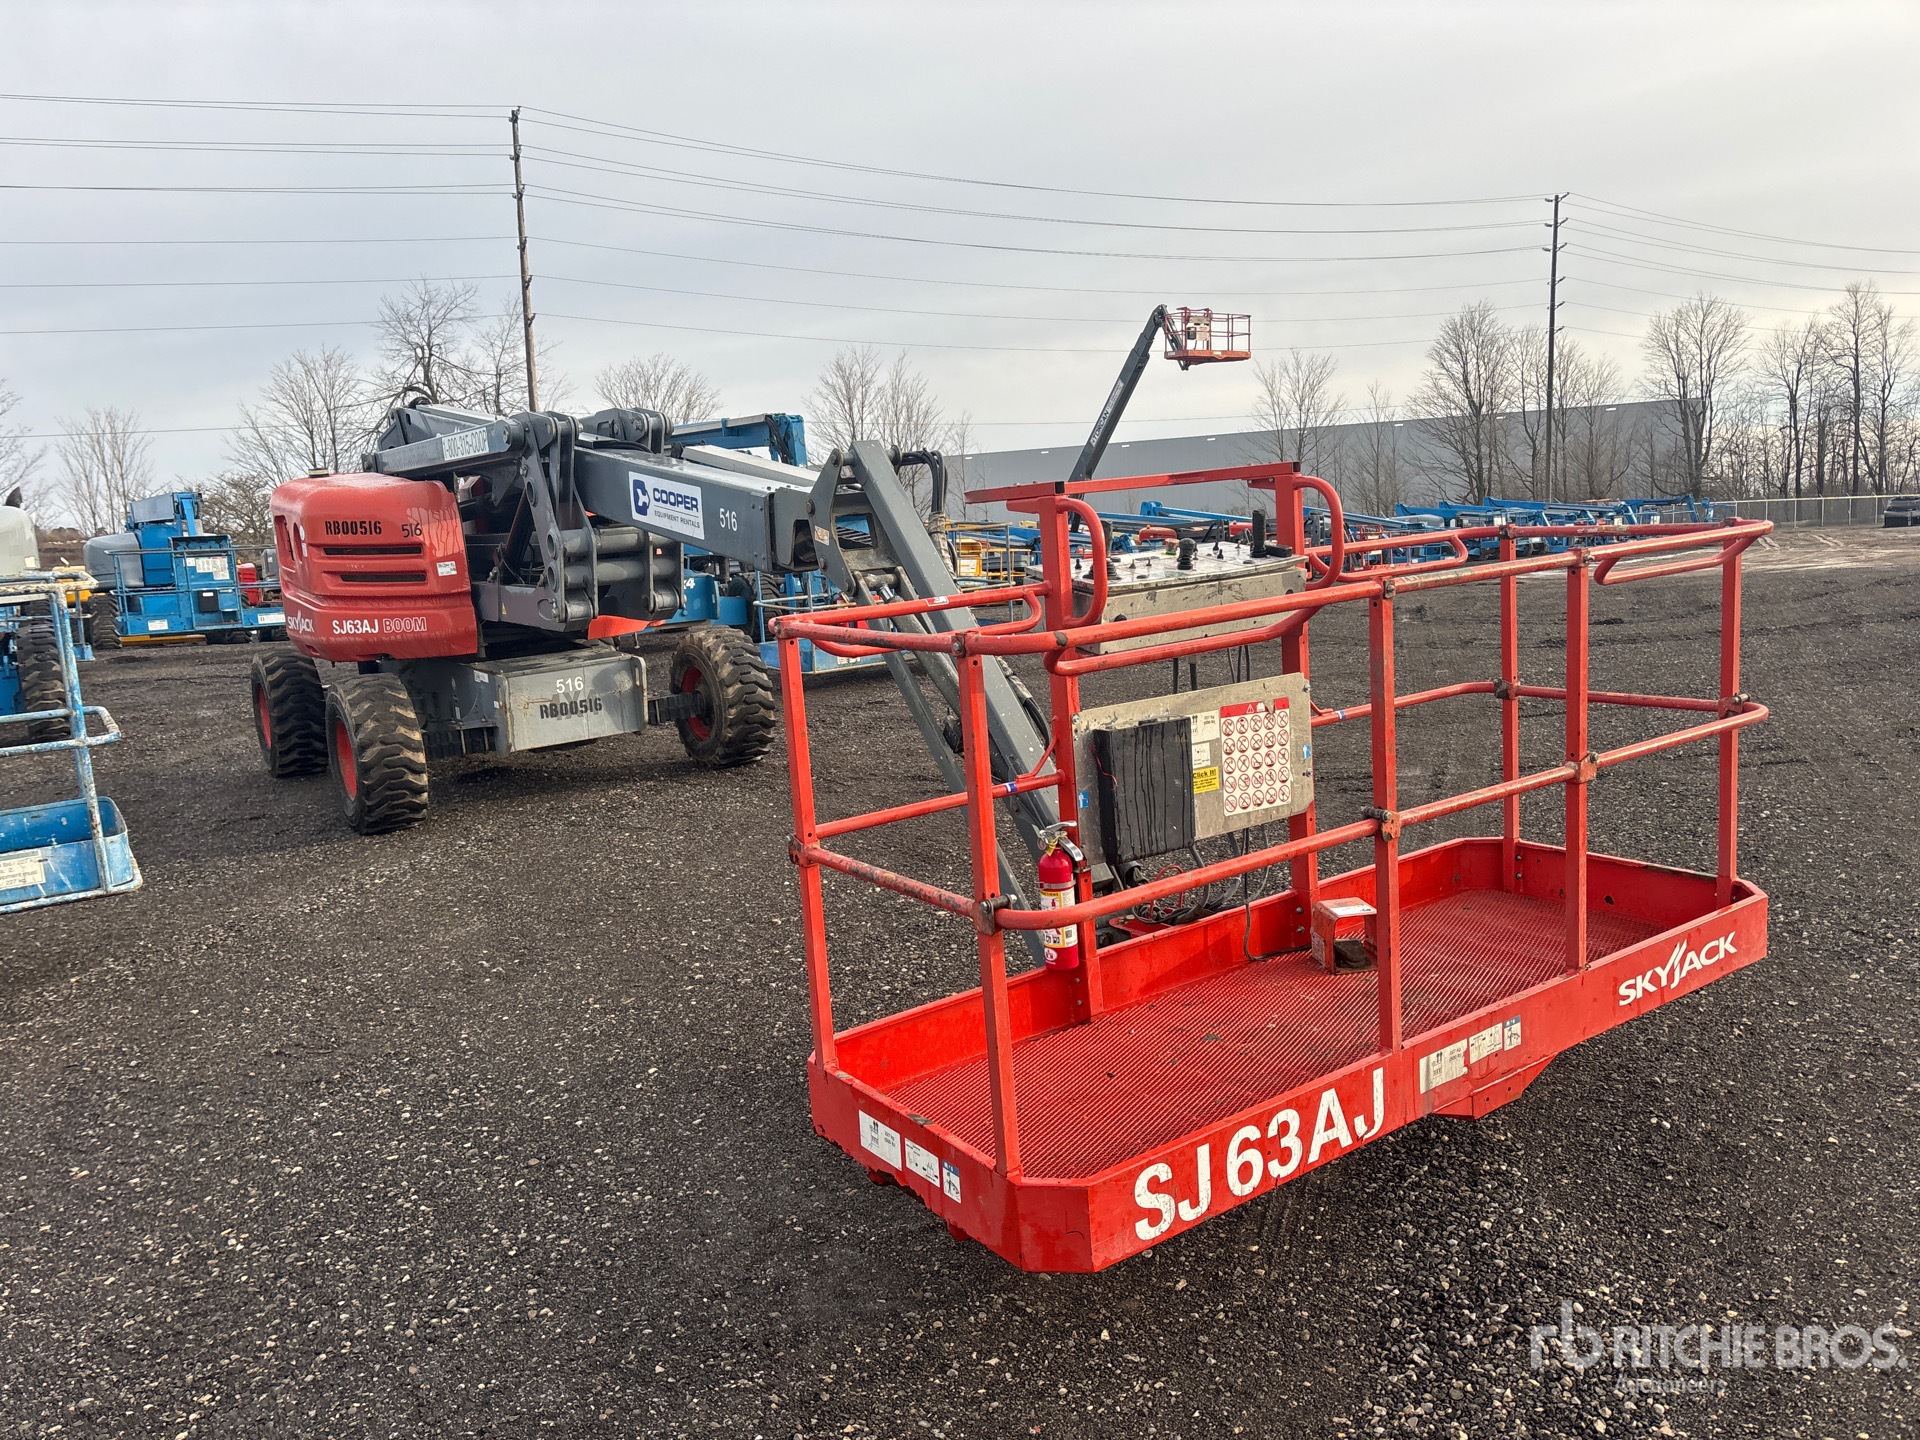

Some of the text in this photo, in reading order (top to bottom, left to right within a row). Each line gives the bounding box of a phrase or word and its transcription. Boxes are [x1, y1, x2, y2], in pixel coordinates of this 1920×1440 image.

[653, 487, 699, 512] COOPER
[325, 520, 382, 536] RB00516
[654, 510, 701, 529] EQUIPMENT RENTALS
[719, 508, 737, 532] 516
[401, 523, 422, 538] 516
[287, 609, 315, 634] SKYJACK
[332, 616, 428, 635] SJ63AJ BOOM
[556, 676, 584, 694] 516
[539, 697, 603, 719] RB00516
[1618, 931, 1738, 1006] SKYJACK
